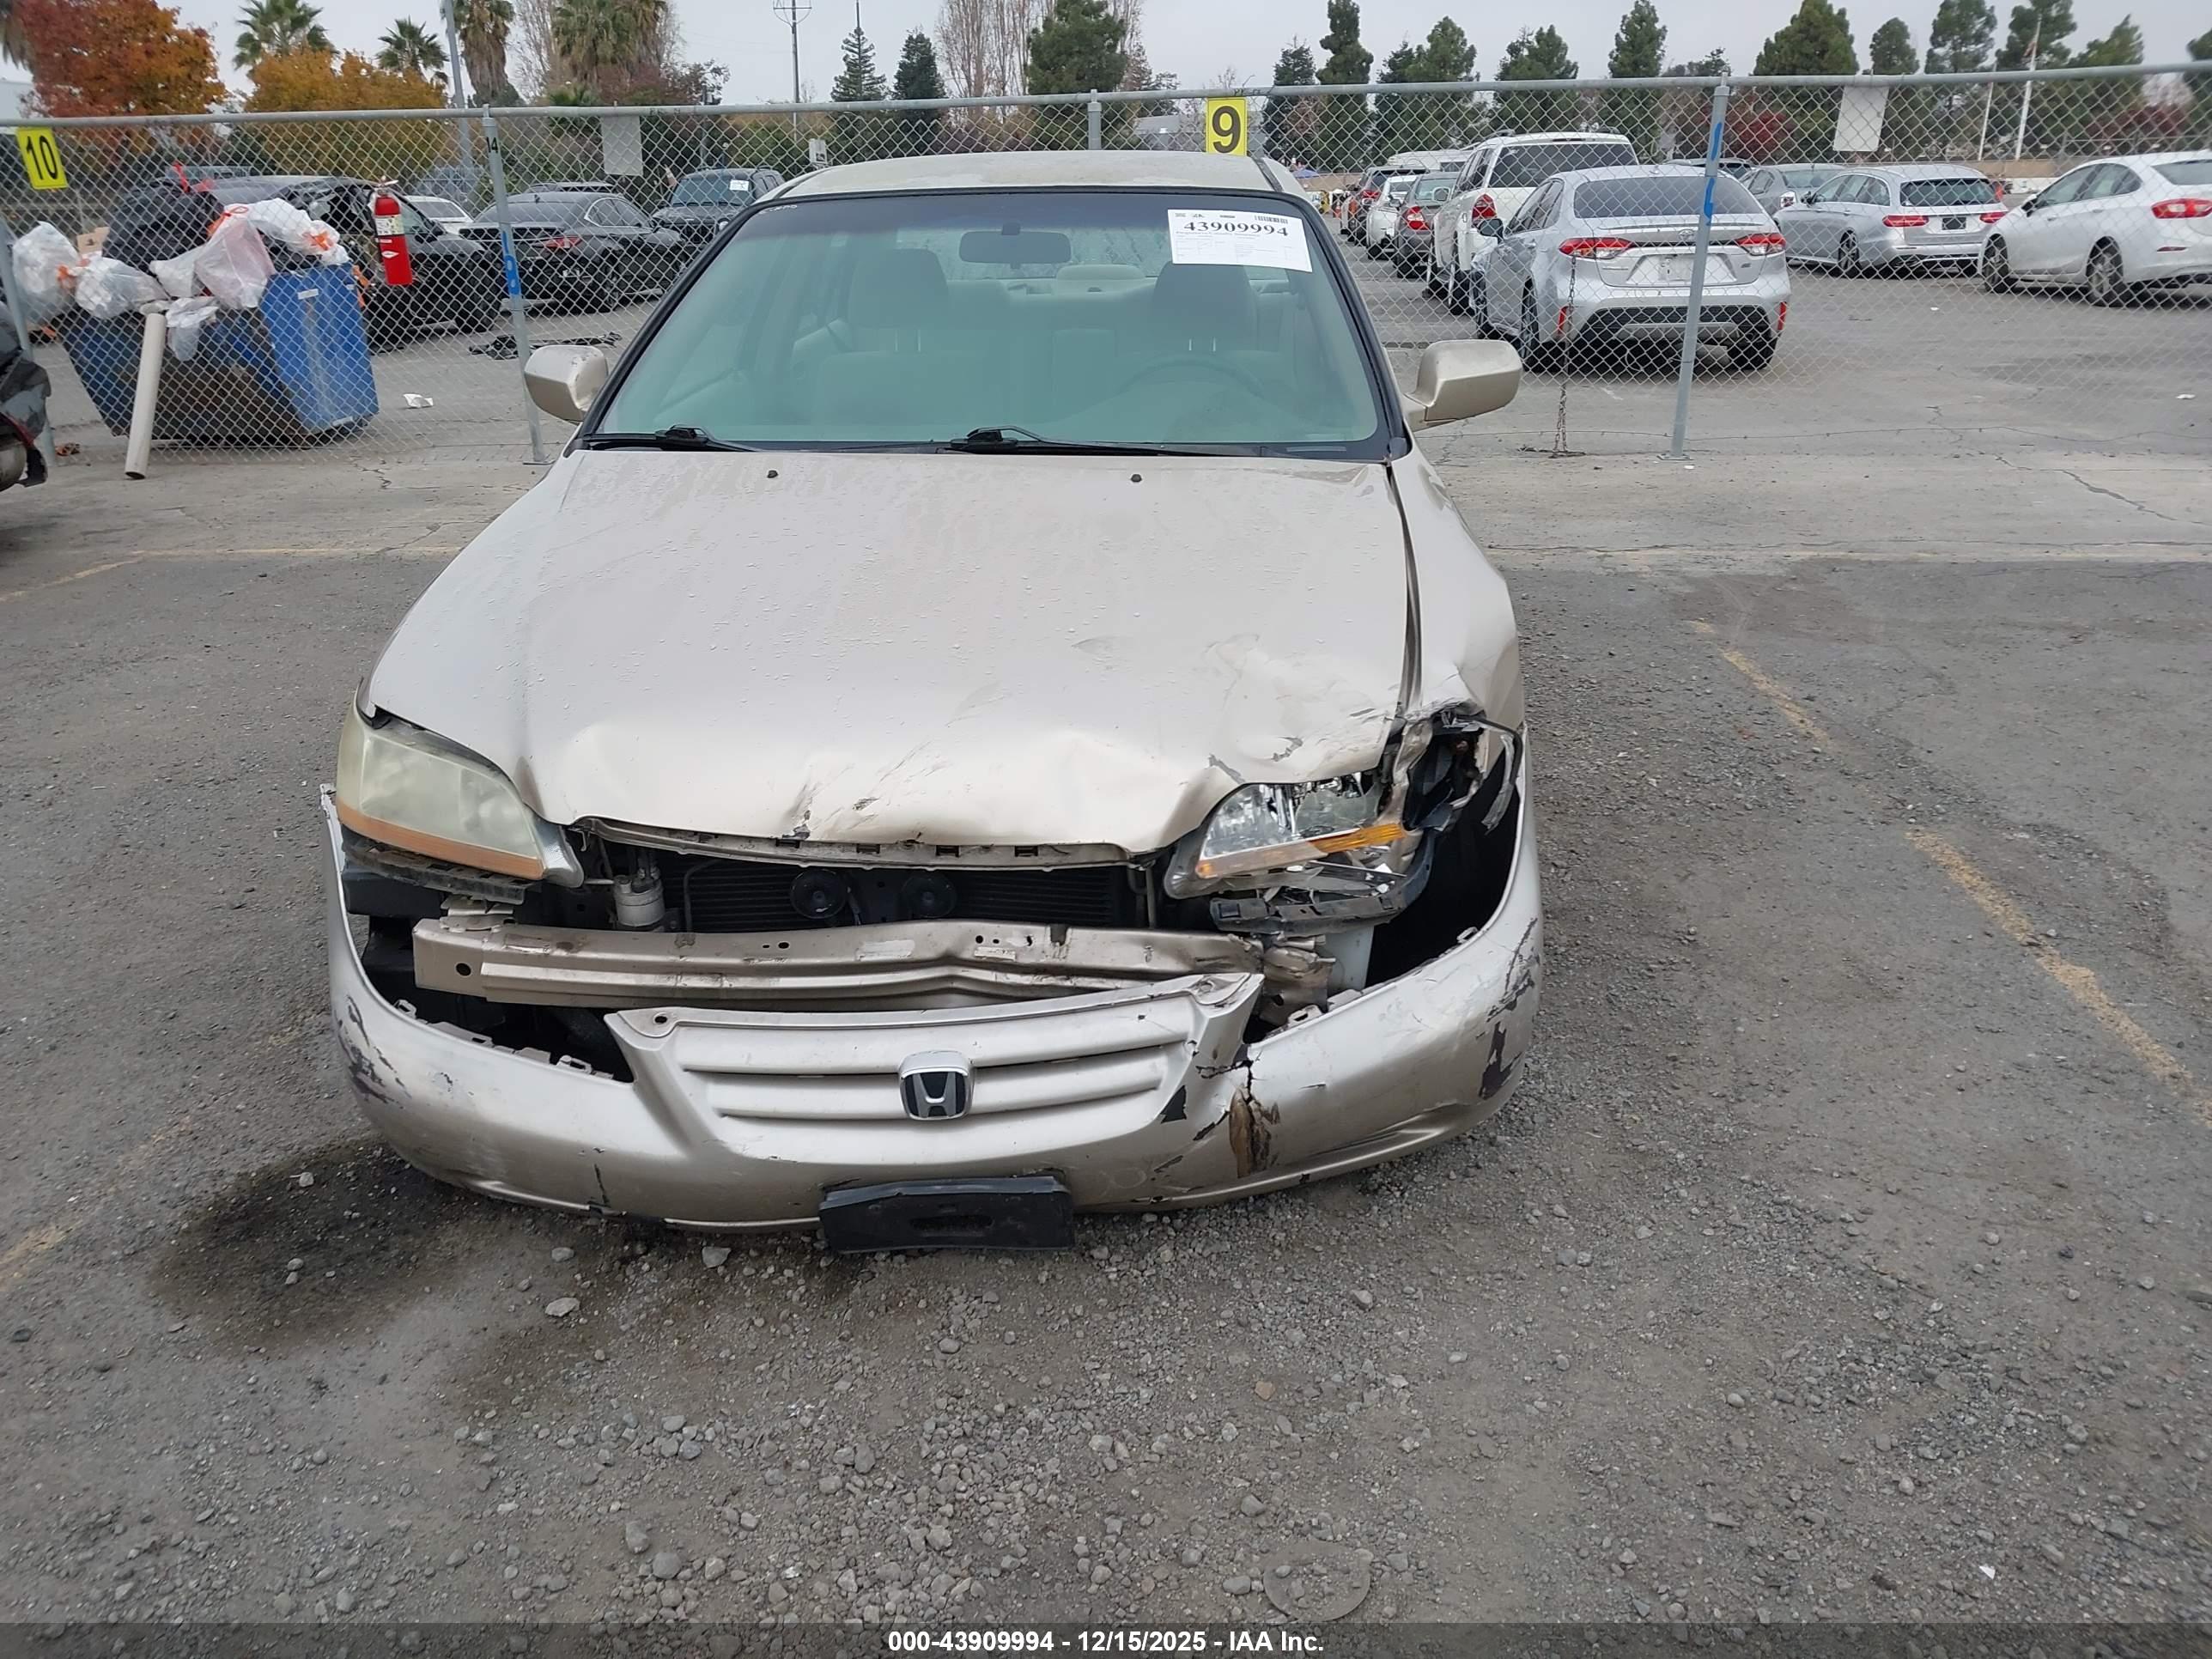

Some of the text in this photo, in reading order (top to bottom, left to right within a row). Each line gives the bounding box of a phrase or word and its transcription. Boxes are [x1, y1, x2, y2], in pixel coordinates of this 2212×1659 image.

[1212, 105, 1241, 154] 9
[27, 135, 58, 180] 10
[486, 137, 498, 154] 14
[1183, 221, 1289, 236] 43909994
